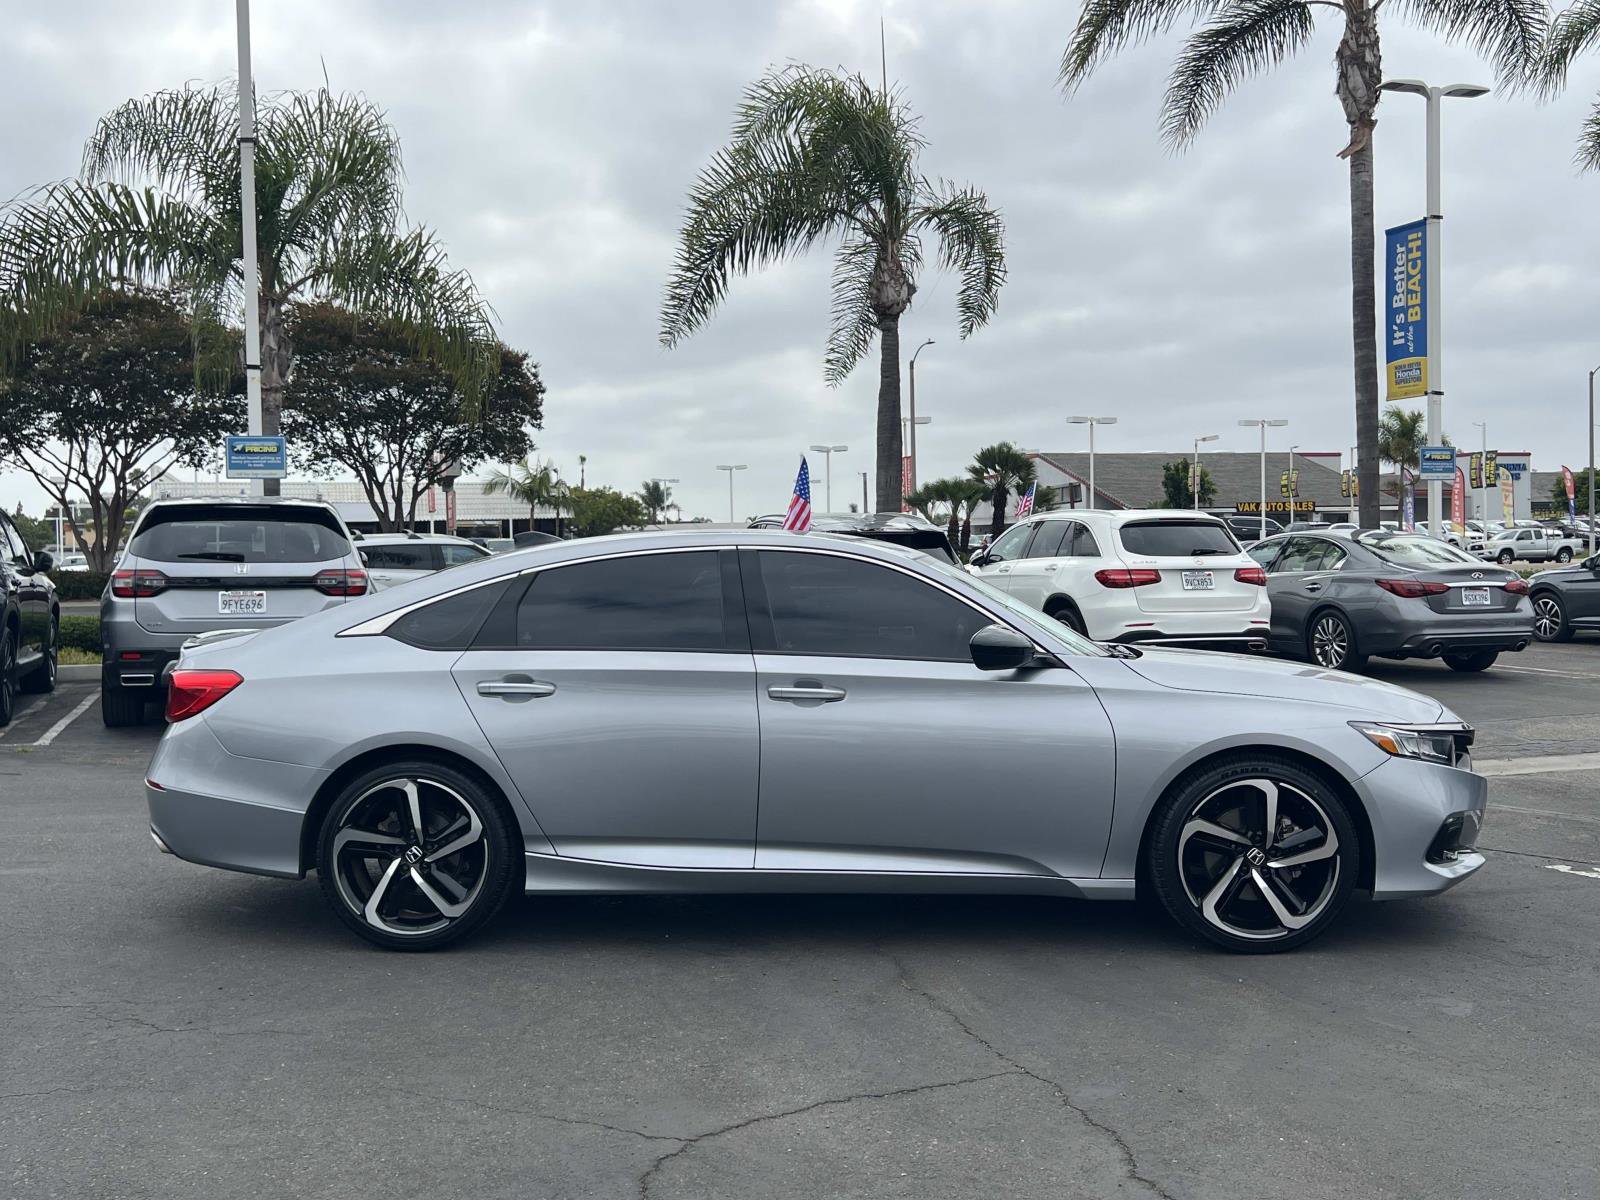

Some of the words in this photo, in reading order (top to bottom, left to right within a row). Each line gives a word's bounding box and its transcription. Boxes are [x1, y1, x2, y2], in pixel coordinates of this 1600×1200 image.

[1393, 243, 1406, 308] Better
[1407, 232, 1422, 323] BEACH!
[1393, 313, 1405, 346] It's
[1396, 368, 1420, 378] Honda
[1237, 502, 1257, 512] VAK
[1285, 501, 1314, 511] SALES
[222, 600, 263, 610] 9FYE696
